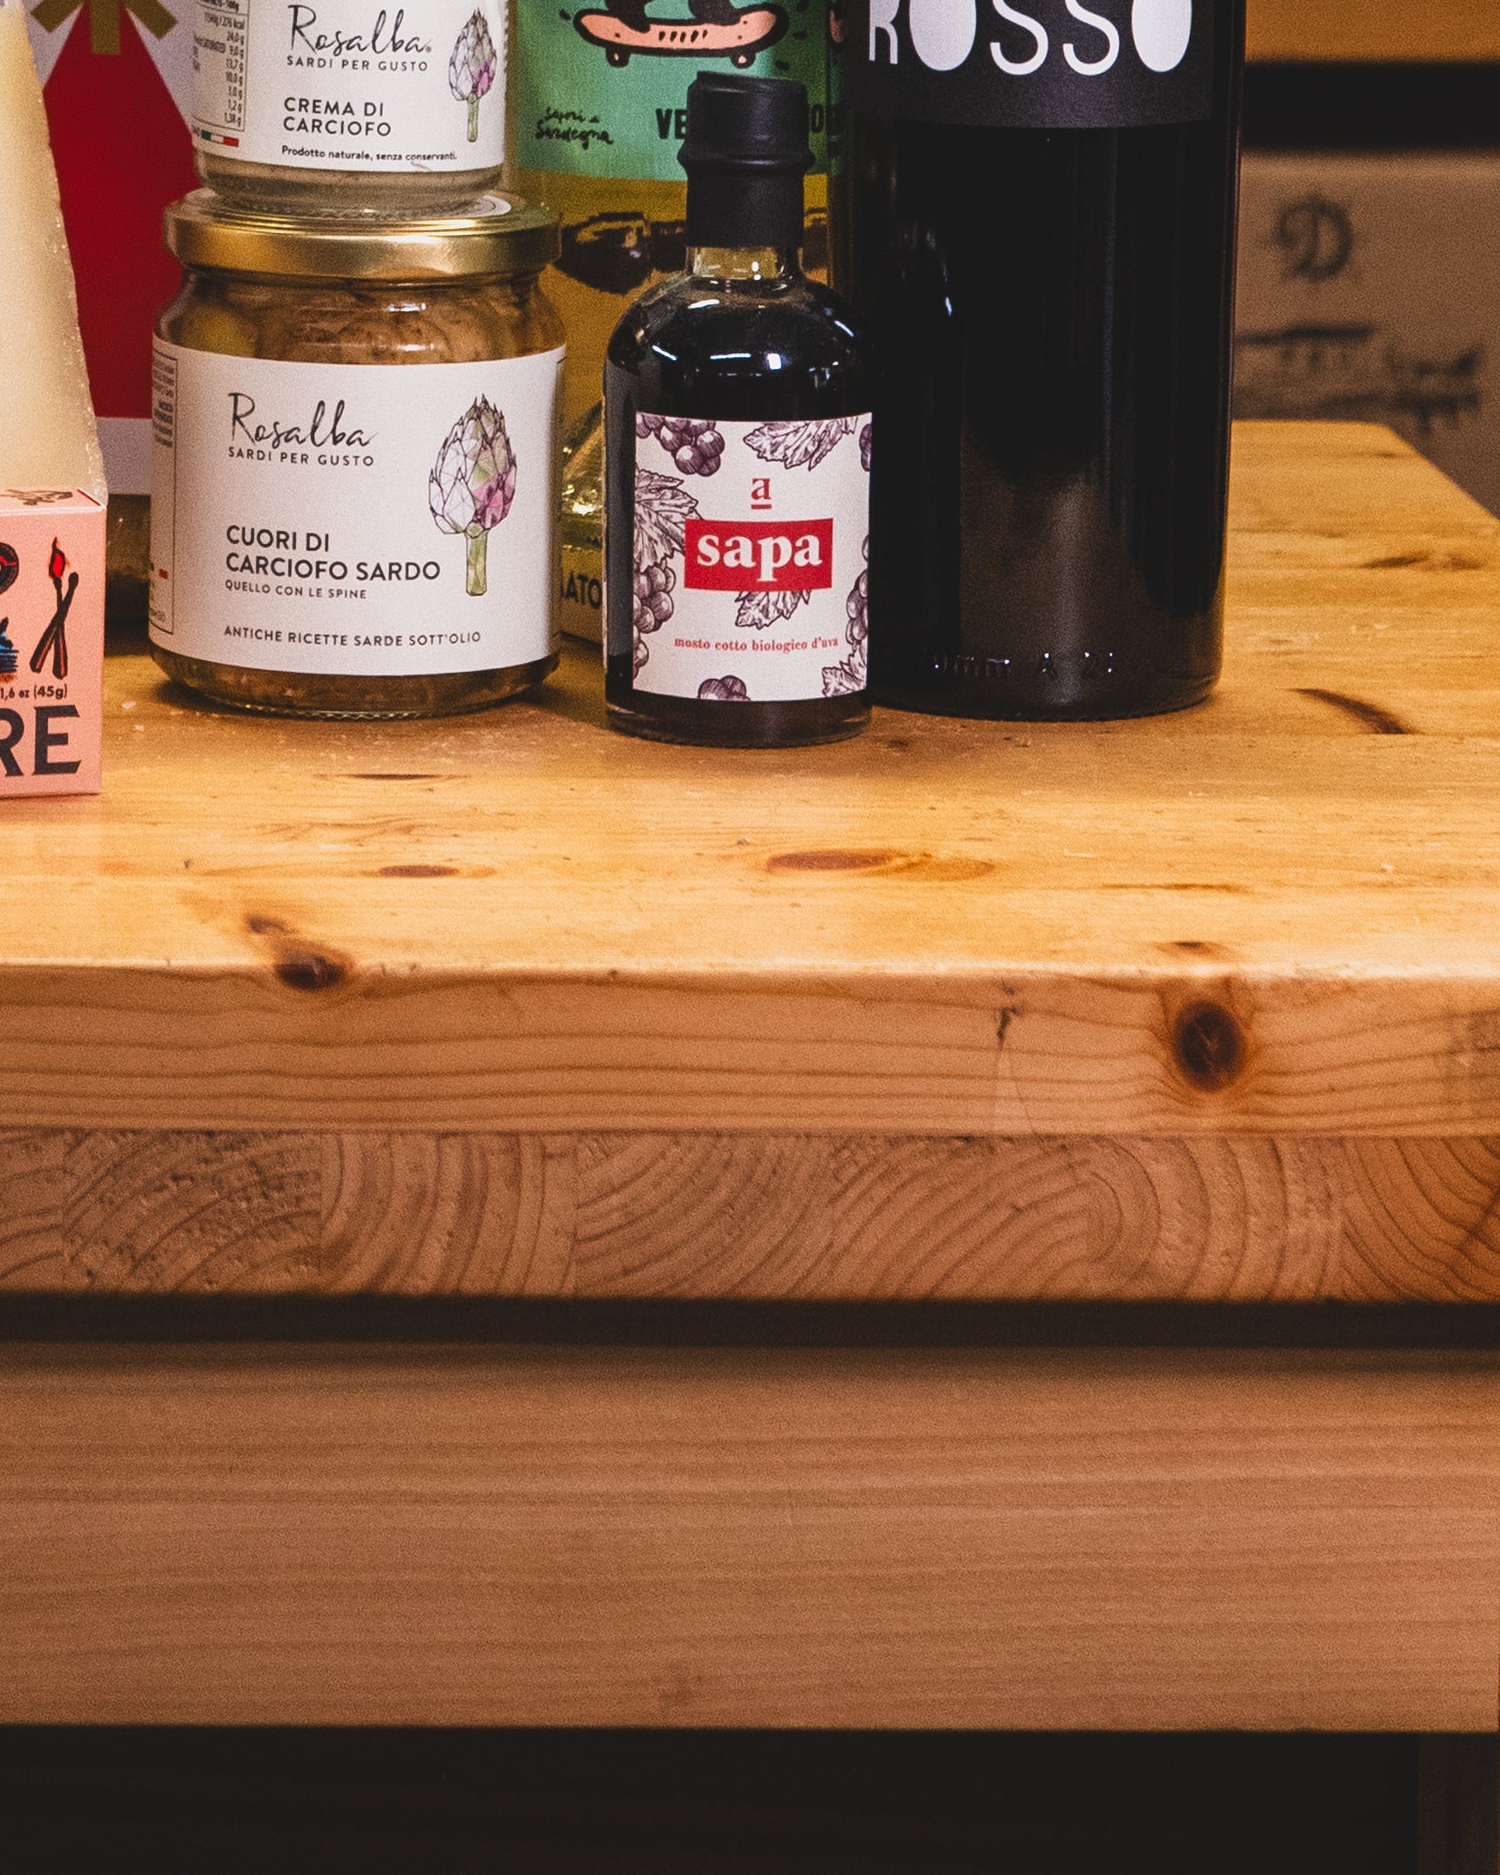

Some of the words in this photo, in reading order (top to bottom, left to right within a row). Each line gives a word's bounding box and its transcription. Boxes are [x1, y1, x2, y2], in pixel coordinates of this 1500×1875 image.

[287, 4, 432, 57] Rosalba
[286, 55, 333, 69] SARDI
[341, 59, 370, 71] PER
[378, 60, 428, 72] GUSTO
[284, 97, 355, 116] CREMA
[364, 102, 383, 116] DI
[283, 116, 391, 136] CARCIOFO
[282, 145, 326, 158] Prodotto
[328, 149, 374, 162] naturale,
[376, 153, 403, 161] senza
[228, 392, 379, 449] Rosalba
[228, 446, 272, 461] SARDI
[280, 452, 309, 465] PER
[318, 454, 374, 467] GUSTO
[226, 524, 297, 550] CUORI
[305, 532, 329, 552] DI
[225, 552, 348, 580] CARCIOFO
[356, 561, 441, 581] SARDO
[697, 534, 822, 582] sapa
[225, 579, 271, 594] QUELLO
[275, 585, 303, 596] CON
[309, 587, 323, 598] LE
[328, 588, 367, 599] SPINE
[223, 625, 283, 642] ANTICHE
[288, 632, 348, 646] RICETTE
[353, 635, 403, 647] SARDE
[408, 631, 481, 645] SOTT'OLIO
[674, 638, 710, 649] mosto
[715, 640, 747, 651] cotto
[751, 638, 808, 653] biologico
[811, 637, 838, 649] d'uva
[19, 690, 29, 698] oz
[33, 683, 67, 700] (45g)
